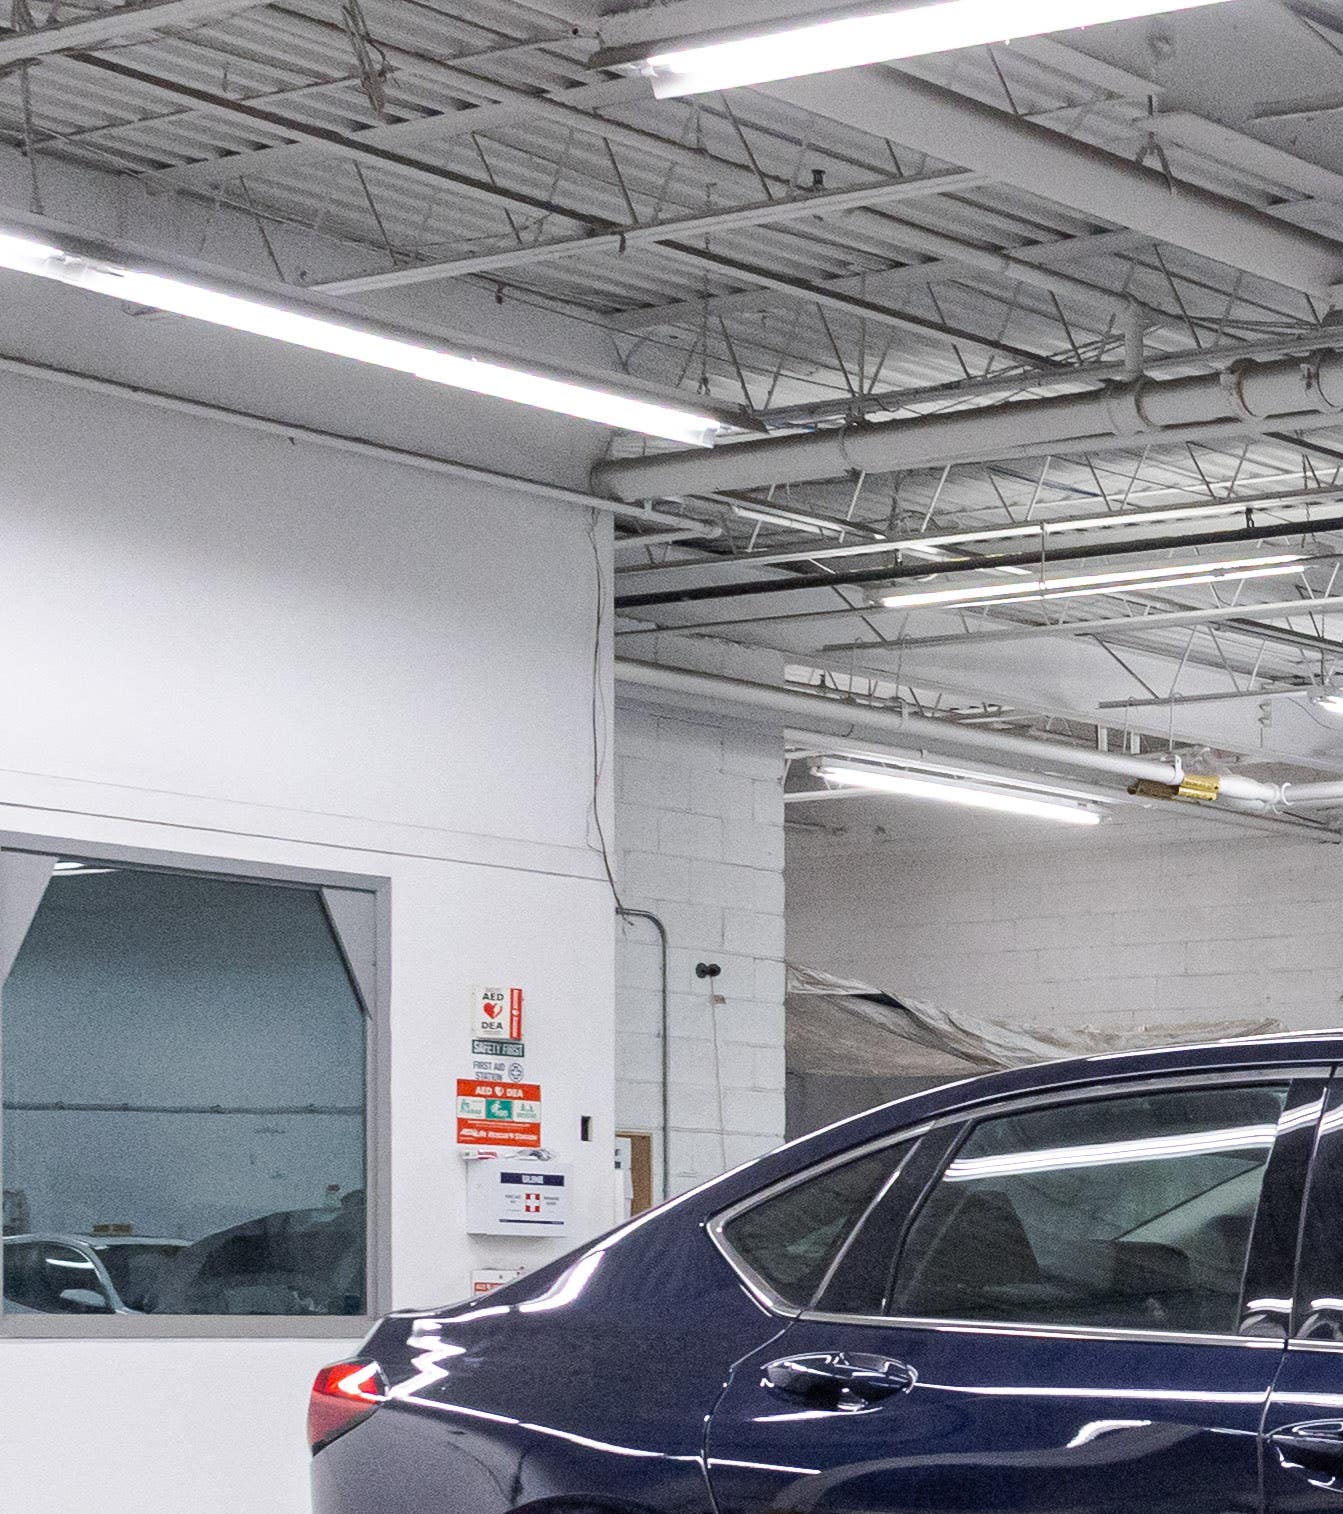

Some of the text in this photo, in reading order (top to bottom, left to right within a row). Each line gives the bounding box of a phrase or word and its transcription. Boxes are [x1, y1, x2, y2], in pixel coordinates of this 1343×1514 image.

[482, 992, 504, 1001] AED
[481, 1021, 503, 1030] DEA
[473, 1040, 523, 1056] SAFETY FIRST
[473, 1061, 505, 1071] FIRST AID
